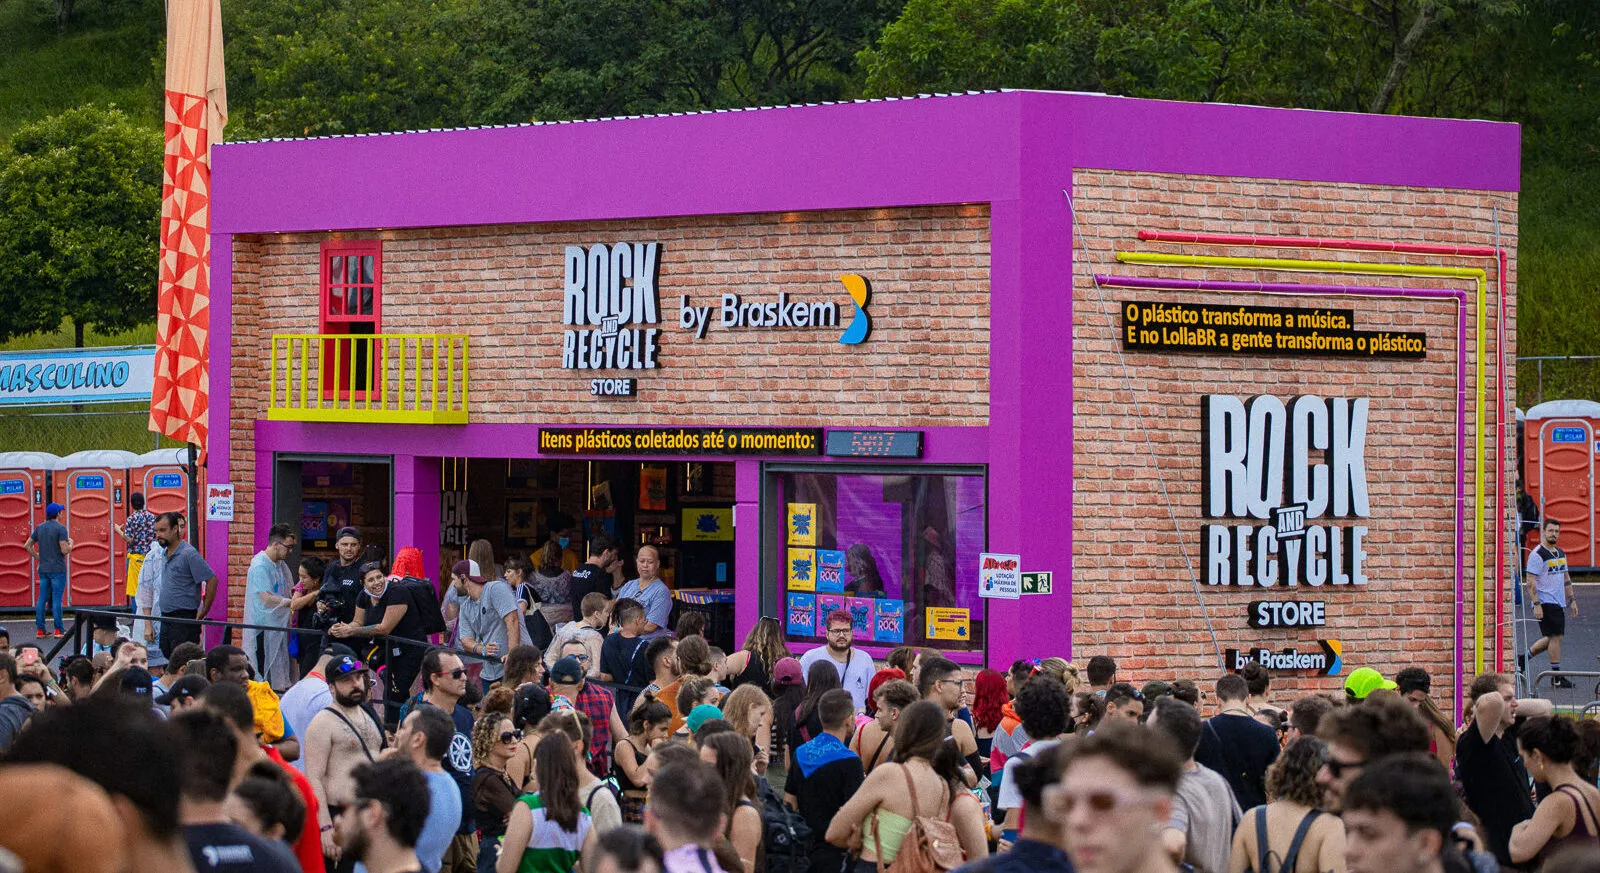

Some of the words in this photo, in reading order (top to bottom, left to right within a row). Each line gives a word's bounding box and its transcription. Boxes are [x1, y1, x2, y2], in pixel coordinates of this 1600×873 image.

[563, 241, 658, 325] ROCK
[602, 318, 618, 334] AND
[679, 294, 710, 339] by
[720, 292, 836, 327] Braskem
[1126, 304, 1139, 322] O
[1142, 304, 1199, 326] plástico
[1202, 306, 1282, 327] transforma
[1285, 313, 1294, 327] a
[1297, 308, 1351, 329] música.
[562, 328, 658, 369] RECYCLE
[1127, 325, 1136, 344] E
[1140, 330, 1159, 345] no
[1162, 326, 1217, 346] LollaBR
[1220, 333, 1229, 347] a
[1232, 331, 1273, 351] gente
[1276, 330, 1354, 350] transforma
[1356, 336, 1366, 350] o
[1369, 333, 1427, 355] plástico.
[590, 378, 631, 396] STORE
[541, 430, 572, 449] Itens
[575, 429, 632, 453] plásticos
[634, 429, 700, 449] coletados
[702, 429, 725, 449] até
[727, 435, 738, 449] o
[740, 431, 815, 449] momento:
[1208, 394, 1370, 519] ROCK
[1277, 509, 1304, 534] AND
[1208, 524, 1369, 587] RECYCLE
[820, 570, 841, 583] ROCK
[790, 613, 812, 627] ROCK
[878, 619, 901, 633] ROCK
[1257, 601, 1326, 626] STORE
[1260, 648, 1326, 669] Braskem
